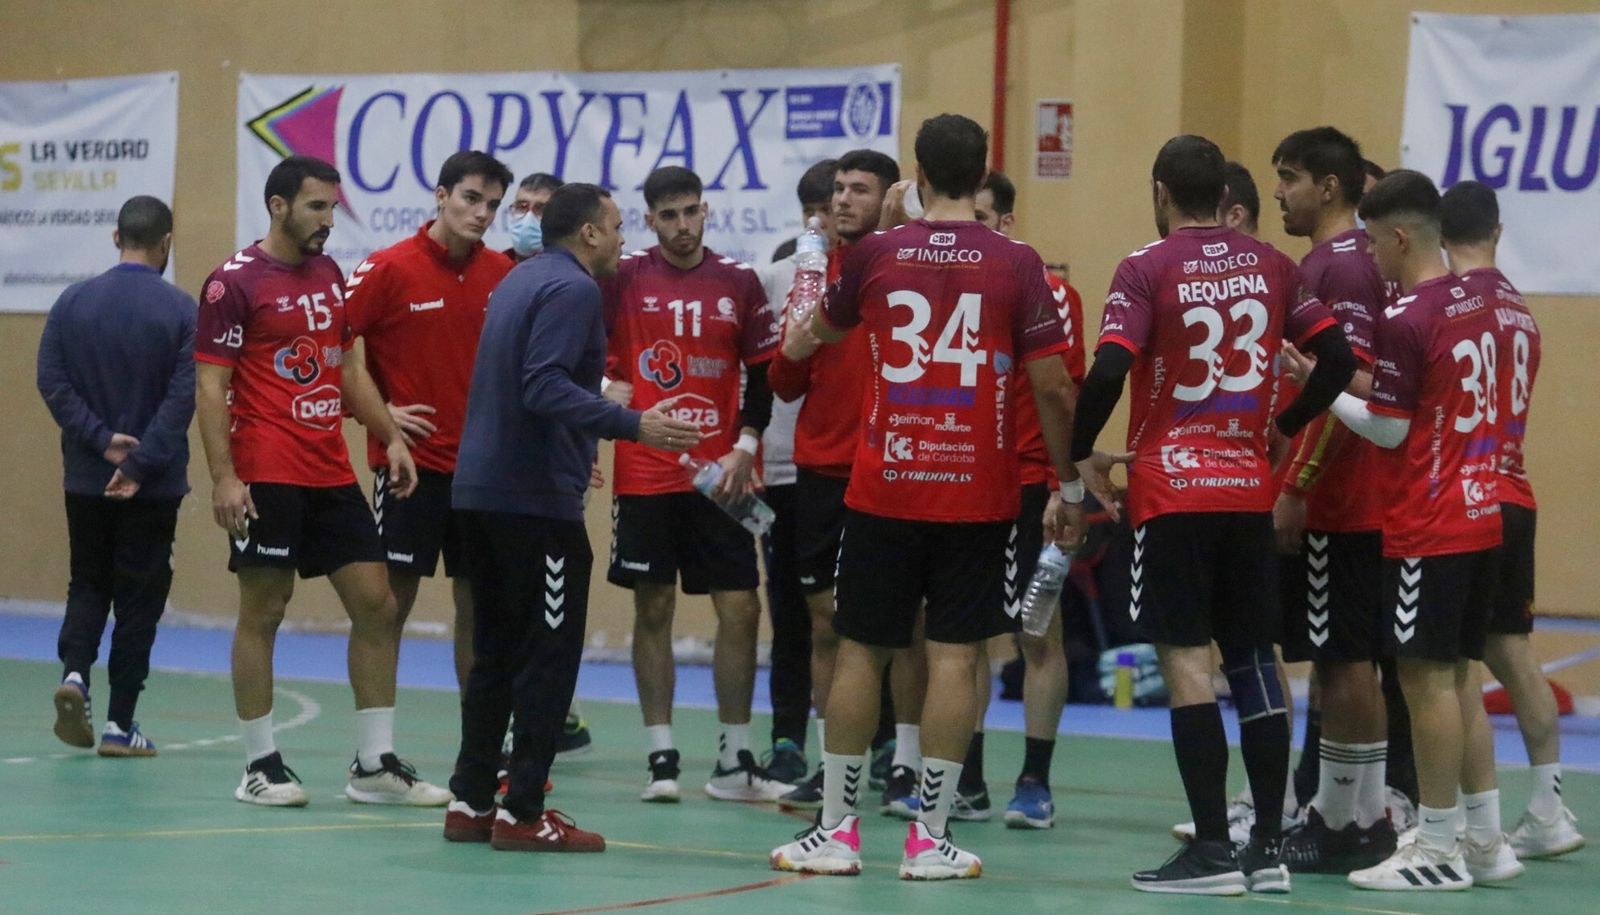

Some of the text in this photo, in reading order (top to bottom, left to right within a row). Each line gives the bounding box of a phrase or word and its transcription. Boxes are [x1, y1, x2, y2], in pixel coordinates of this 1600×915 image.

[31, 138, 149, 162] LA VERDAD
[347, 88, 779, 193] COPYFAX
[1440, 103, 1600, 192] IGLU
[918, 248, 982, 263] IMDECO
[1200, 253, 1258, 274] IMDECO
[1204, 245, 1226, 254] CBM
[1177, 274, 1269, 306] REQUENA
[297, 292, 333, 331] 15
[667, 299, 703, 337] 11
[1332, 301, 1369, 315] PETROIL
[881, 290, 987, 387] 34
[1172, 298, 1269, 402] 33
[1150, 357, 1167, 400] Kappa
[1451, 331, 1498, 434] 38
[1511, 329, 1530, 416] 8
[917, 452, 976, 463] de Córdoba
[918, 440, 975, 453] Diputación
[901, 471, 972, 482] CORDOPLAS
[1191, 477, 1260, 488] CORDOPLAS
[257, 543, 290, 557] hummel
